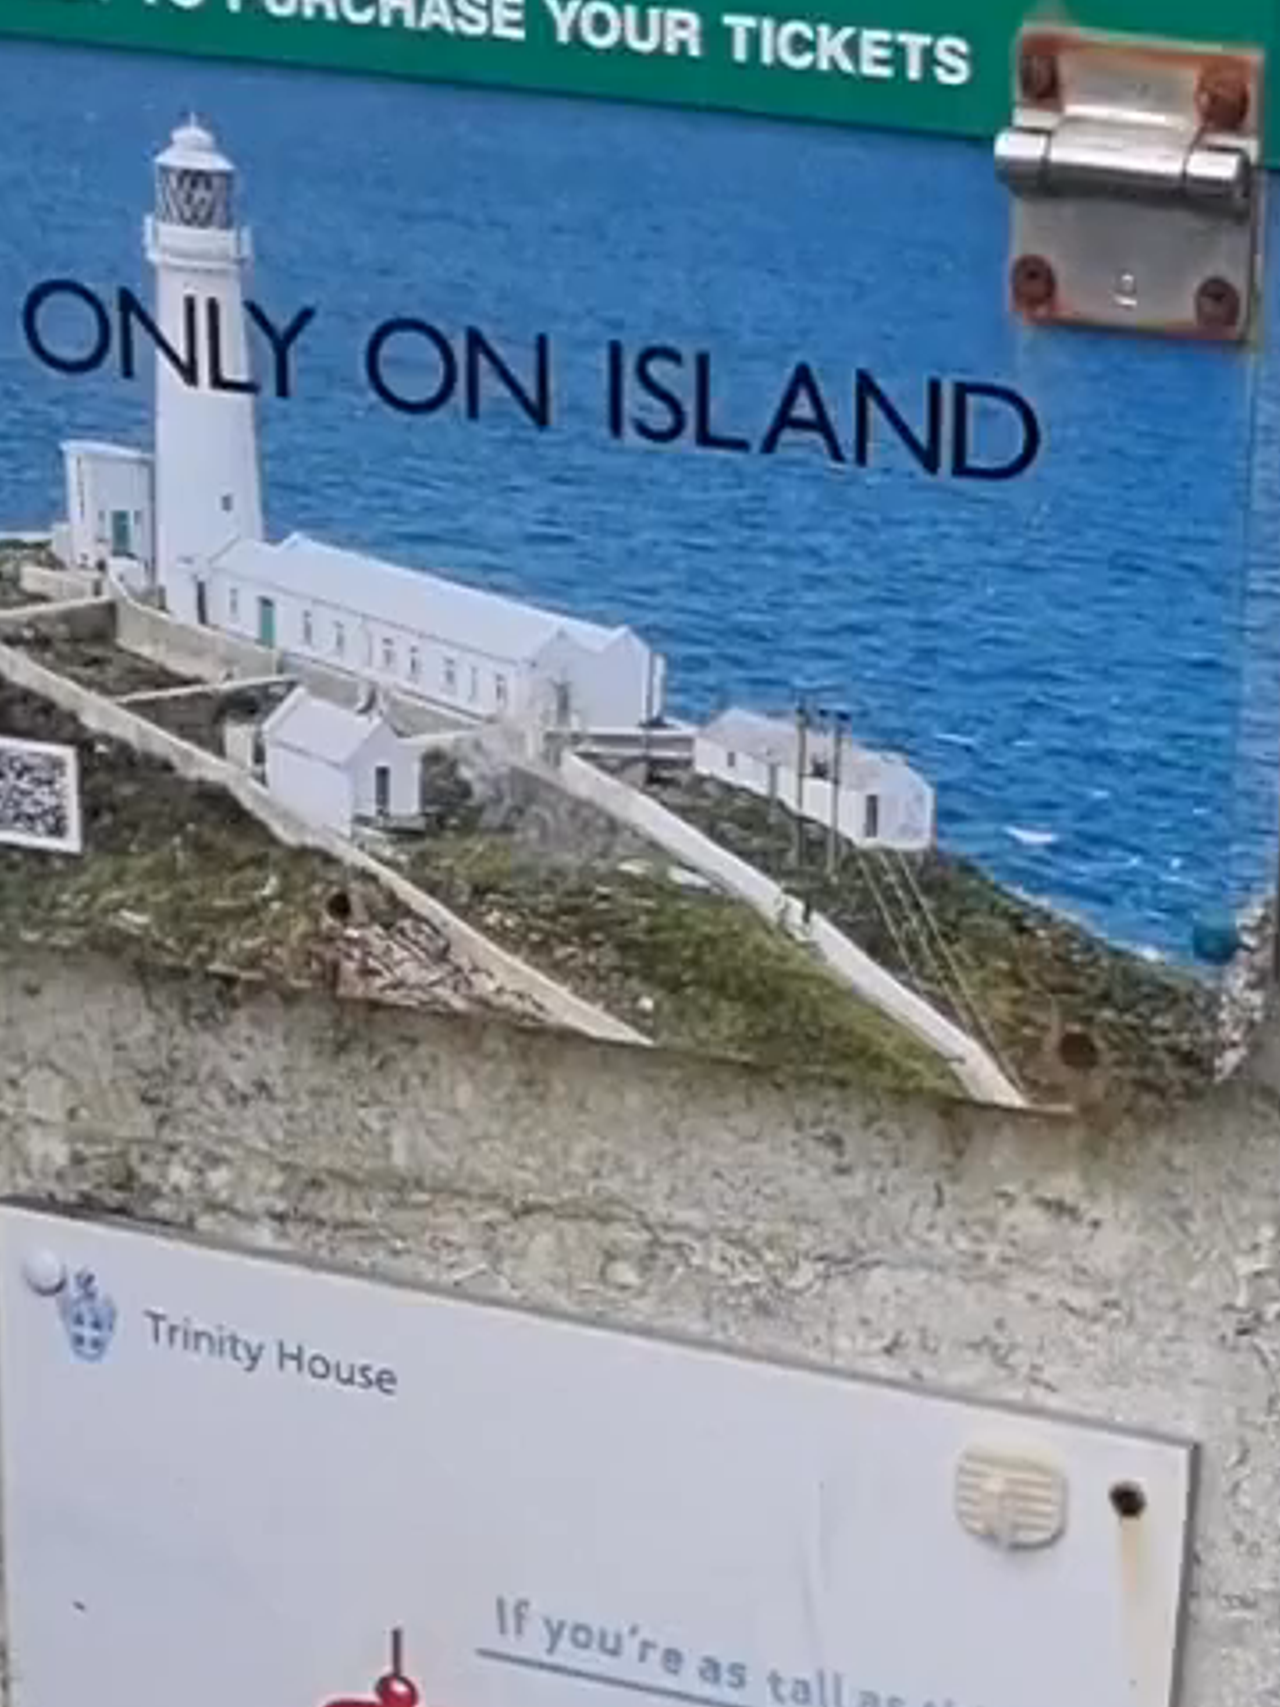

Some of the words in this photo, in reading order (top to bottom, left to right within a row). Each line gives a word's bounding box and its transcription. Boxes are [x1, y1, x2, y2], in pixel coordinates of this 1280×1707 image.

[722, 14, 971, 86] TICKETS
[23, 279, 315, 400] ONLY
[366, 318, 551, 430] ON
[607, 340, 1041, 482] ISLAND
[144, 1309, 266, 1373] Trinity
[277, 1339, 399, 1396] House
[494, 1595, 532, 1639] If
[542, 1615, 685, 1678] you're
[697, 1654, 749, 1692] as
